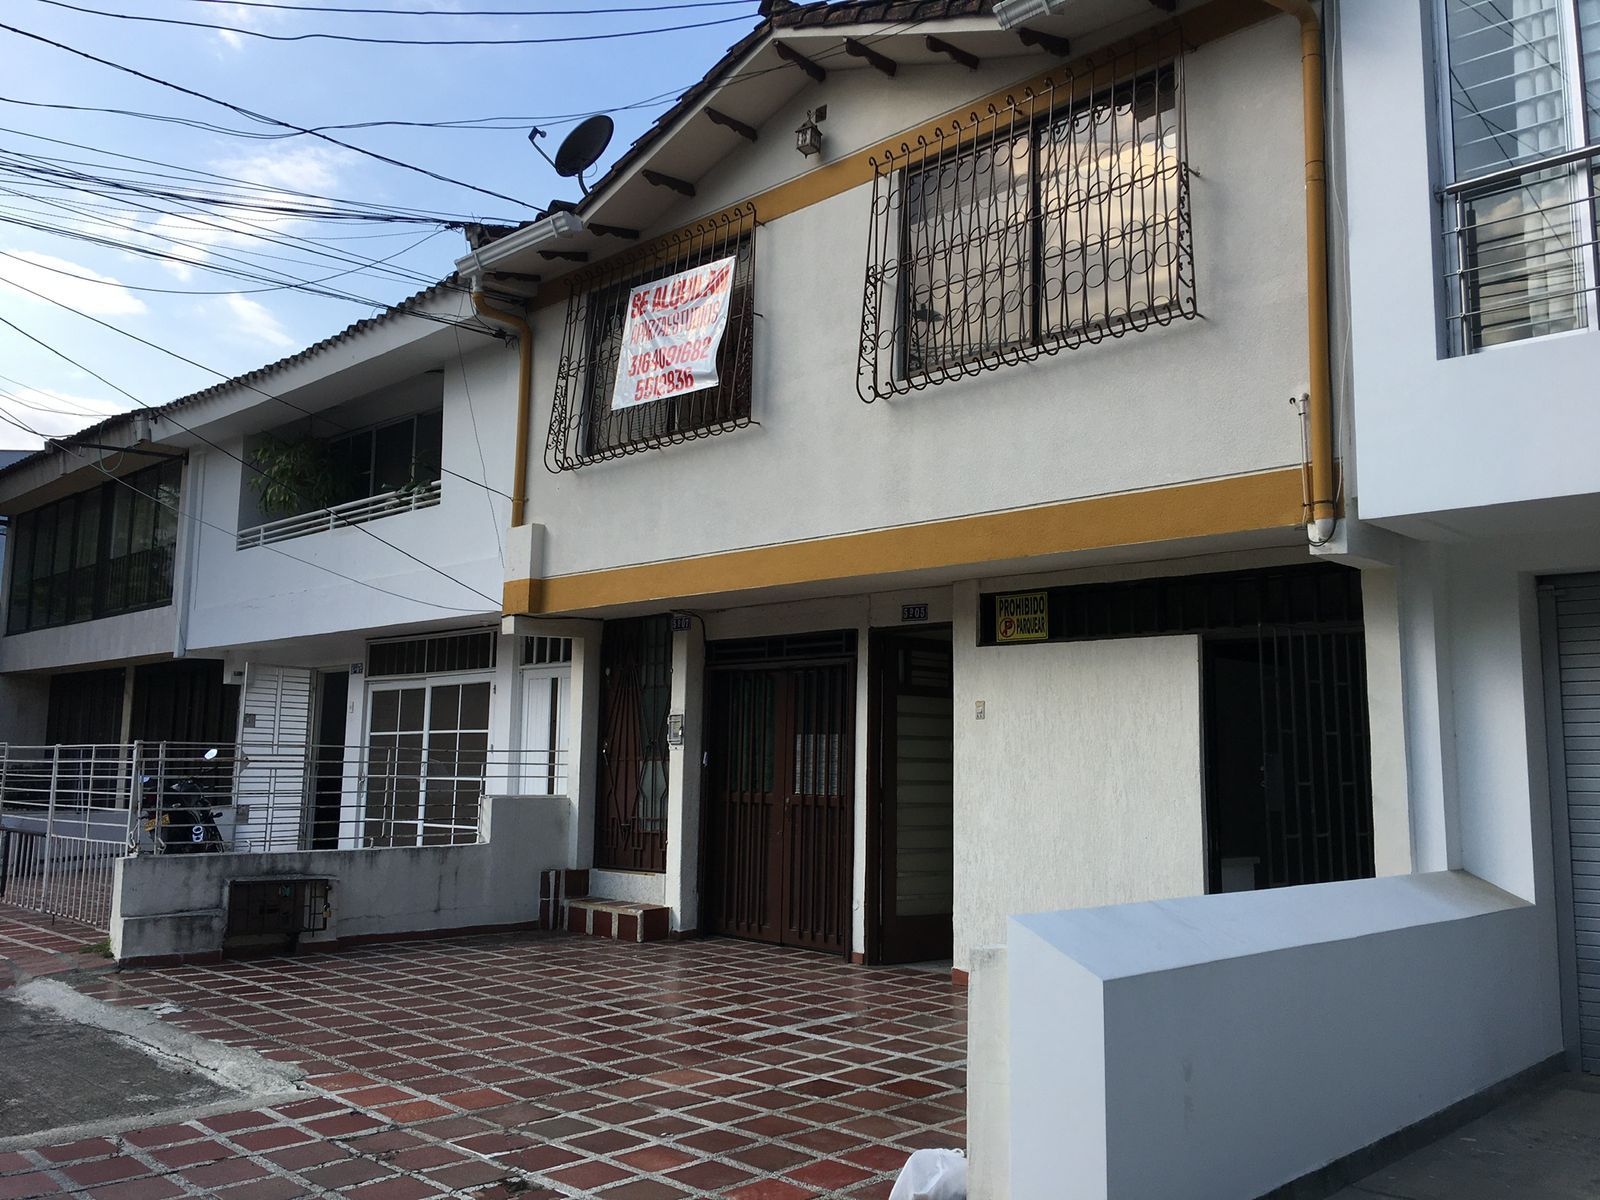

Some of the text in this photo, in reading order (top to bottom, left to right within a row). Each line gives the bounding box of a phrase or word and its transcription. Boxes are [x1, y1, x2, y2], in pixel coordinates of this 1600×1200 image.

[631, 289, 650, 319] SE
[630, 300, 720, 345] APARTAESTUDIOS
[999, 596, 1045, 617] PROHIBIDO
[1016, 616, 1046, 635] PARQUEAR
